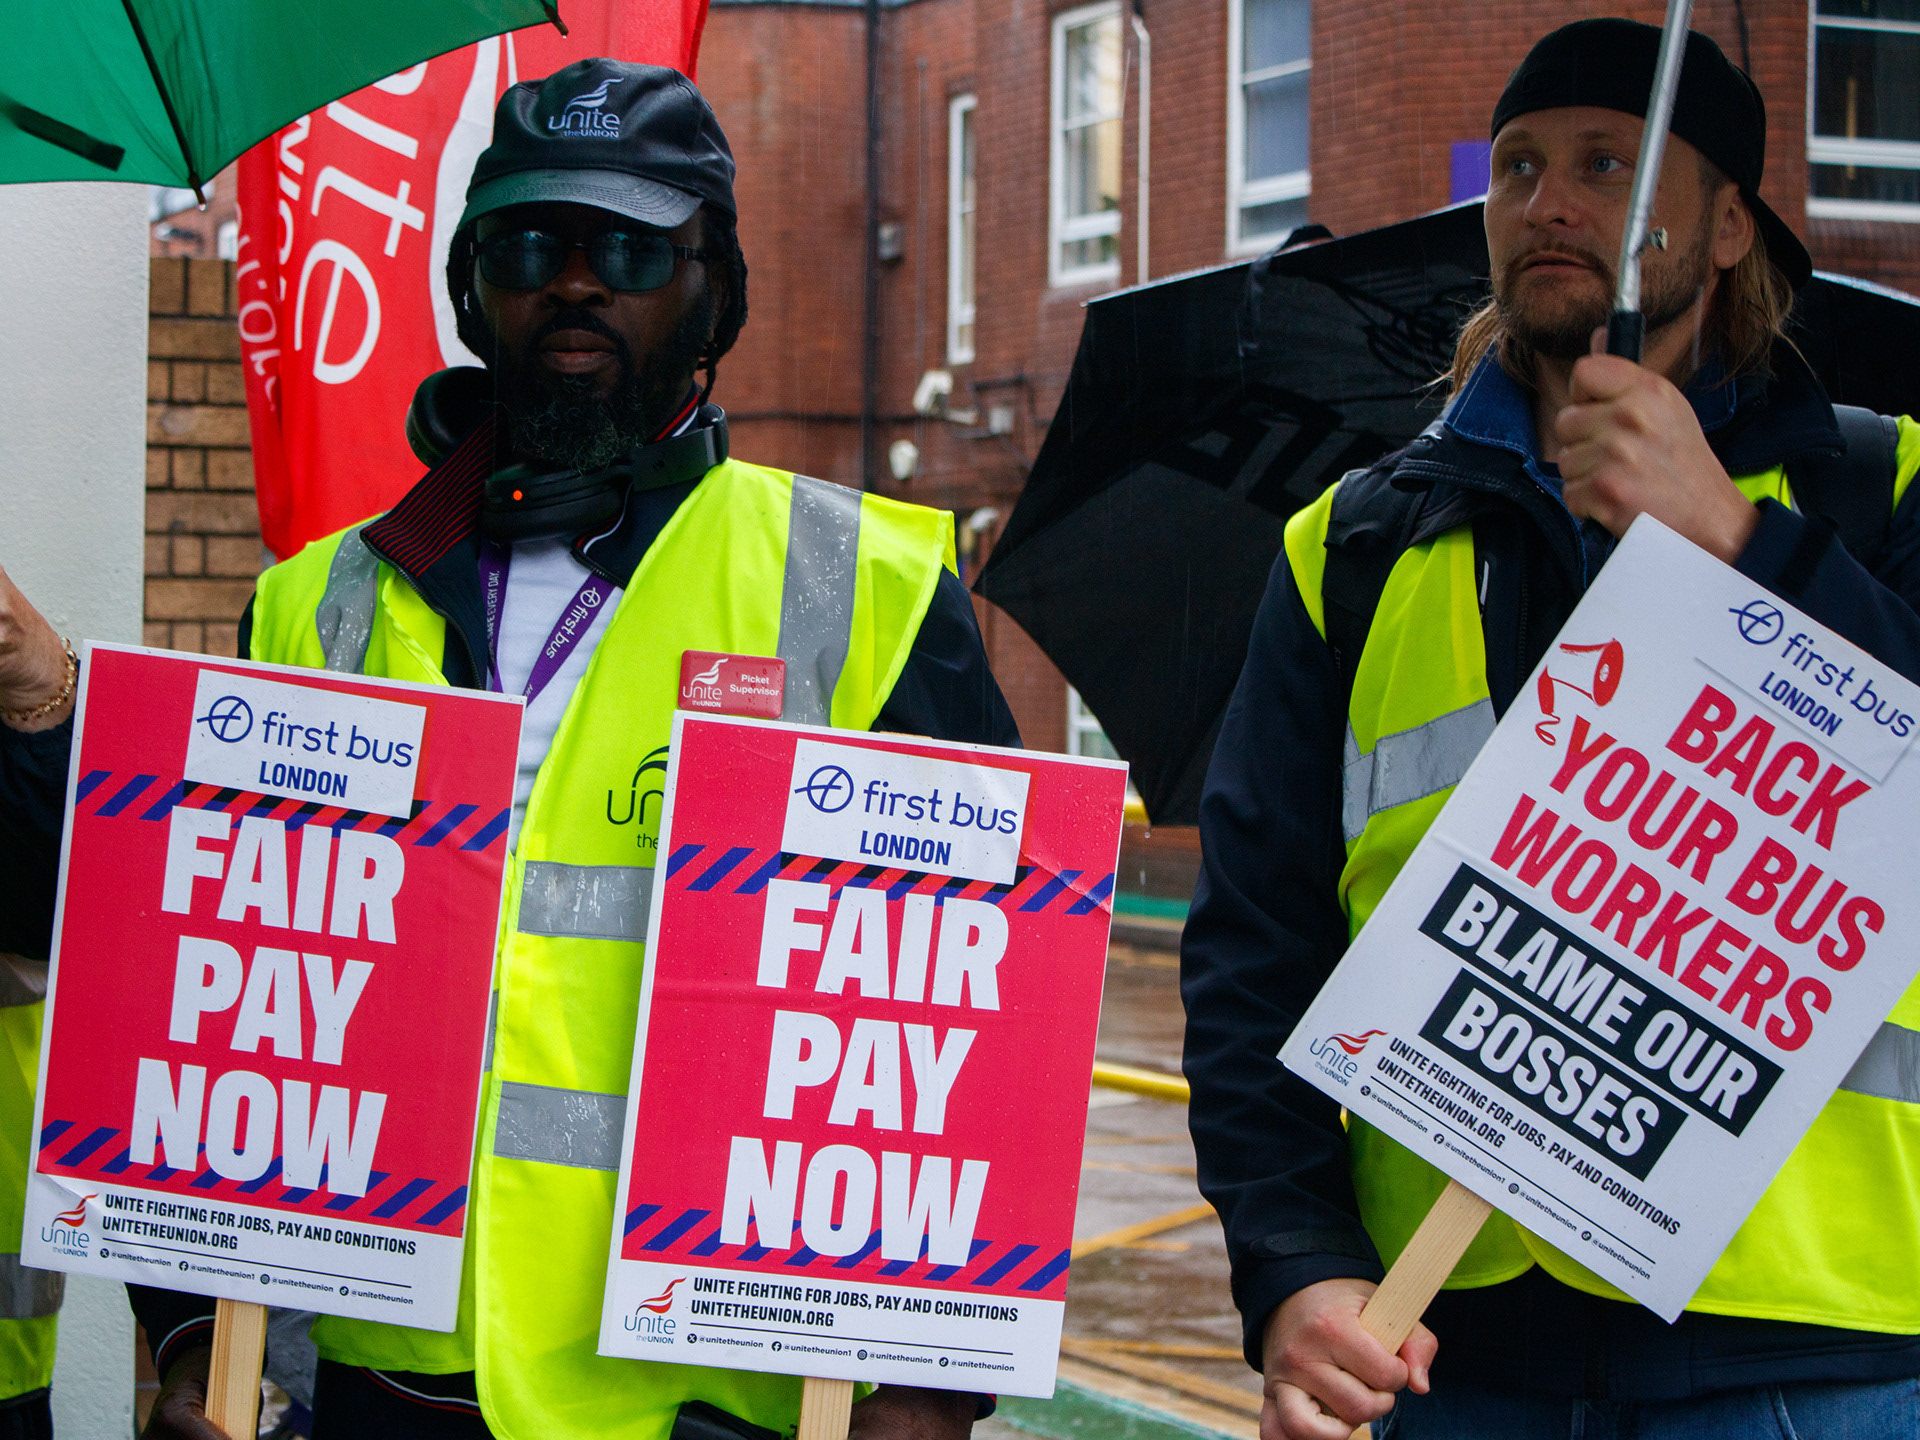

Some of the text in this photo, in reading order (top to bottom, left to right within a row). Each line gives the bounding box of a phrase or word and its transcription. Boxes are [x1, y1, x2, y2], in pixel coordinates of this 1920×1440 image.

[548, 108, 620, 130] unite
[563, 129, 619, 138] theUNION
[487, 588, 499, 615] EVERY
[546, 604, 588, 659] first bus
[682, 685, 723, 700] unite
[692, 700, 721, 708] theUNION
[729, 684, 780, 696] Supervisor
[741, 674, 770, 685] Picket
[1759, 670, 1843, 737] LONDON
[1781, 633, 1916, 737] first bus
[262, 711, 414, 767] first bus
[259, 761, 348, 797] LONDON
[1665, 683, 1872, 852] BACK
[863, 780, 1018, 835] first bus
[859, 830, 952, 866] LONDON
[1550, 713, 1885, 972] YOUR BUS
[161, 805, 405, 945] FAIR
[756, 878, 1009, 1011] FAIR
[1490, 793, 1833, 1053] WORKERS
[169, 935, 375, 1065] PAY
[1442, 883, 1758, 1120] BLAME OUR
[762, 1009, 978, 1135] PAY
[1309, 1038, 1358, 1078] unite
[1315, 1061, 1349, 1087] theUNION
[1442, 987, 1660, 1157] BOSSES
[129, 1057, 387, 1198] NOW
[1376, 1056, 1506, 1149] UNITETHEUNION.ORG
[1389, 1037, 1681, 1236] UNITE FIGHTING FOR JOBS, PAY AND CONDITIONS
[719, 1136, 990, 1267] NOW
[1370, 1092, 1650, 1280] @unitetheunion @unitetheunion1 @unitetheunion @unitetheunion
[41, 1226, 90, 1249] unite
[52, 1246, 89, 1258] theUNION
[102, 1215, 239, 1250] UNITETHEUNION.ORG
[105, 1194, 417, 1256] UNITE FIGHTING FOR JOBS, PAY AND CONDITIONS
[111, 1251, 414, 1305] @unitetheunion @unitetheunion1 @unitetheunion @unitetheunion
[693, 1277, 1019, 1322] UNITE FIGHTING FOR JOBS, PAY AND CONDITIONS
[624, 1314, 676, 1334] unite
[636, 1334, 674, 1345] theUNION
[691, 1299, 834, 1327] UNITETHEUNION.ORG
[699, 1335, 1015, 1372] @unitetheunion @unitetheunion1 @unitetheunion @unitetheunion
